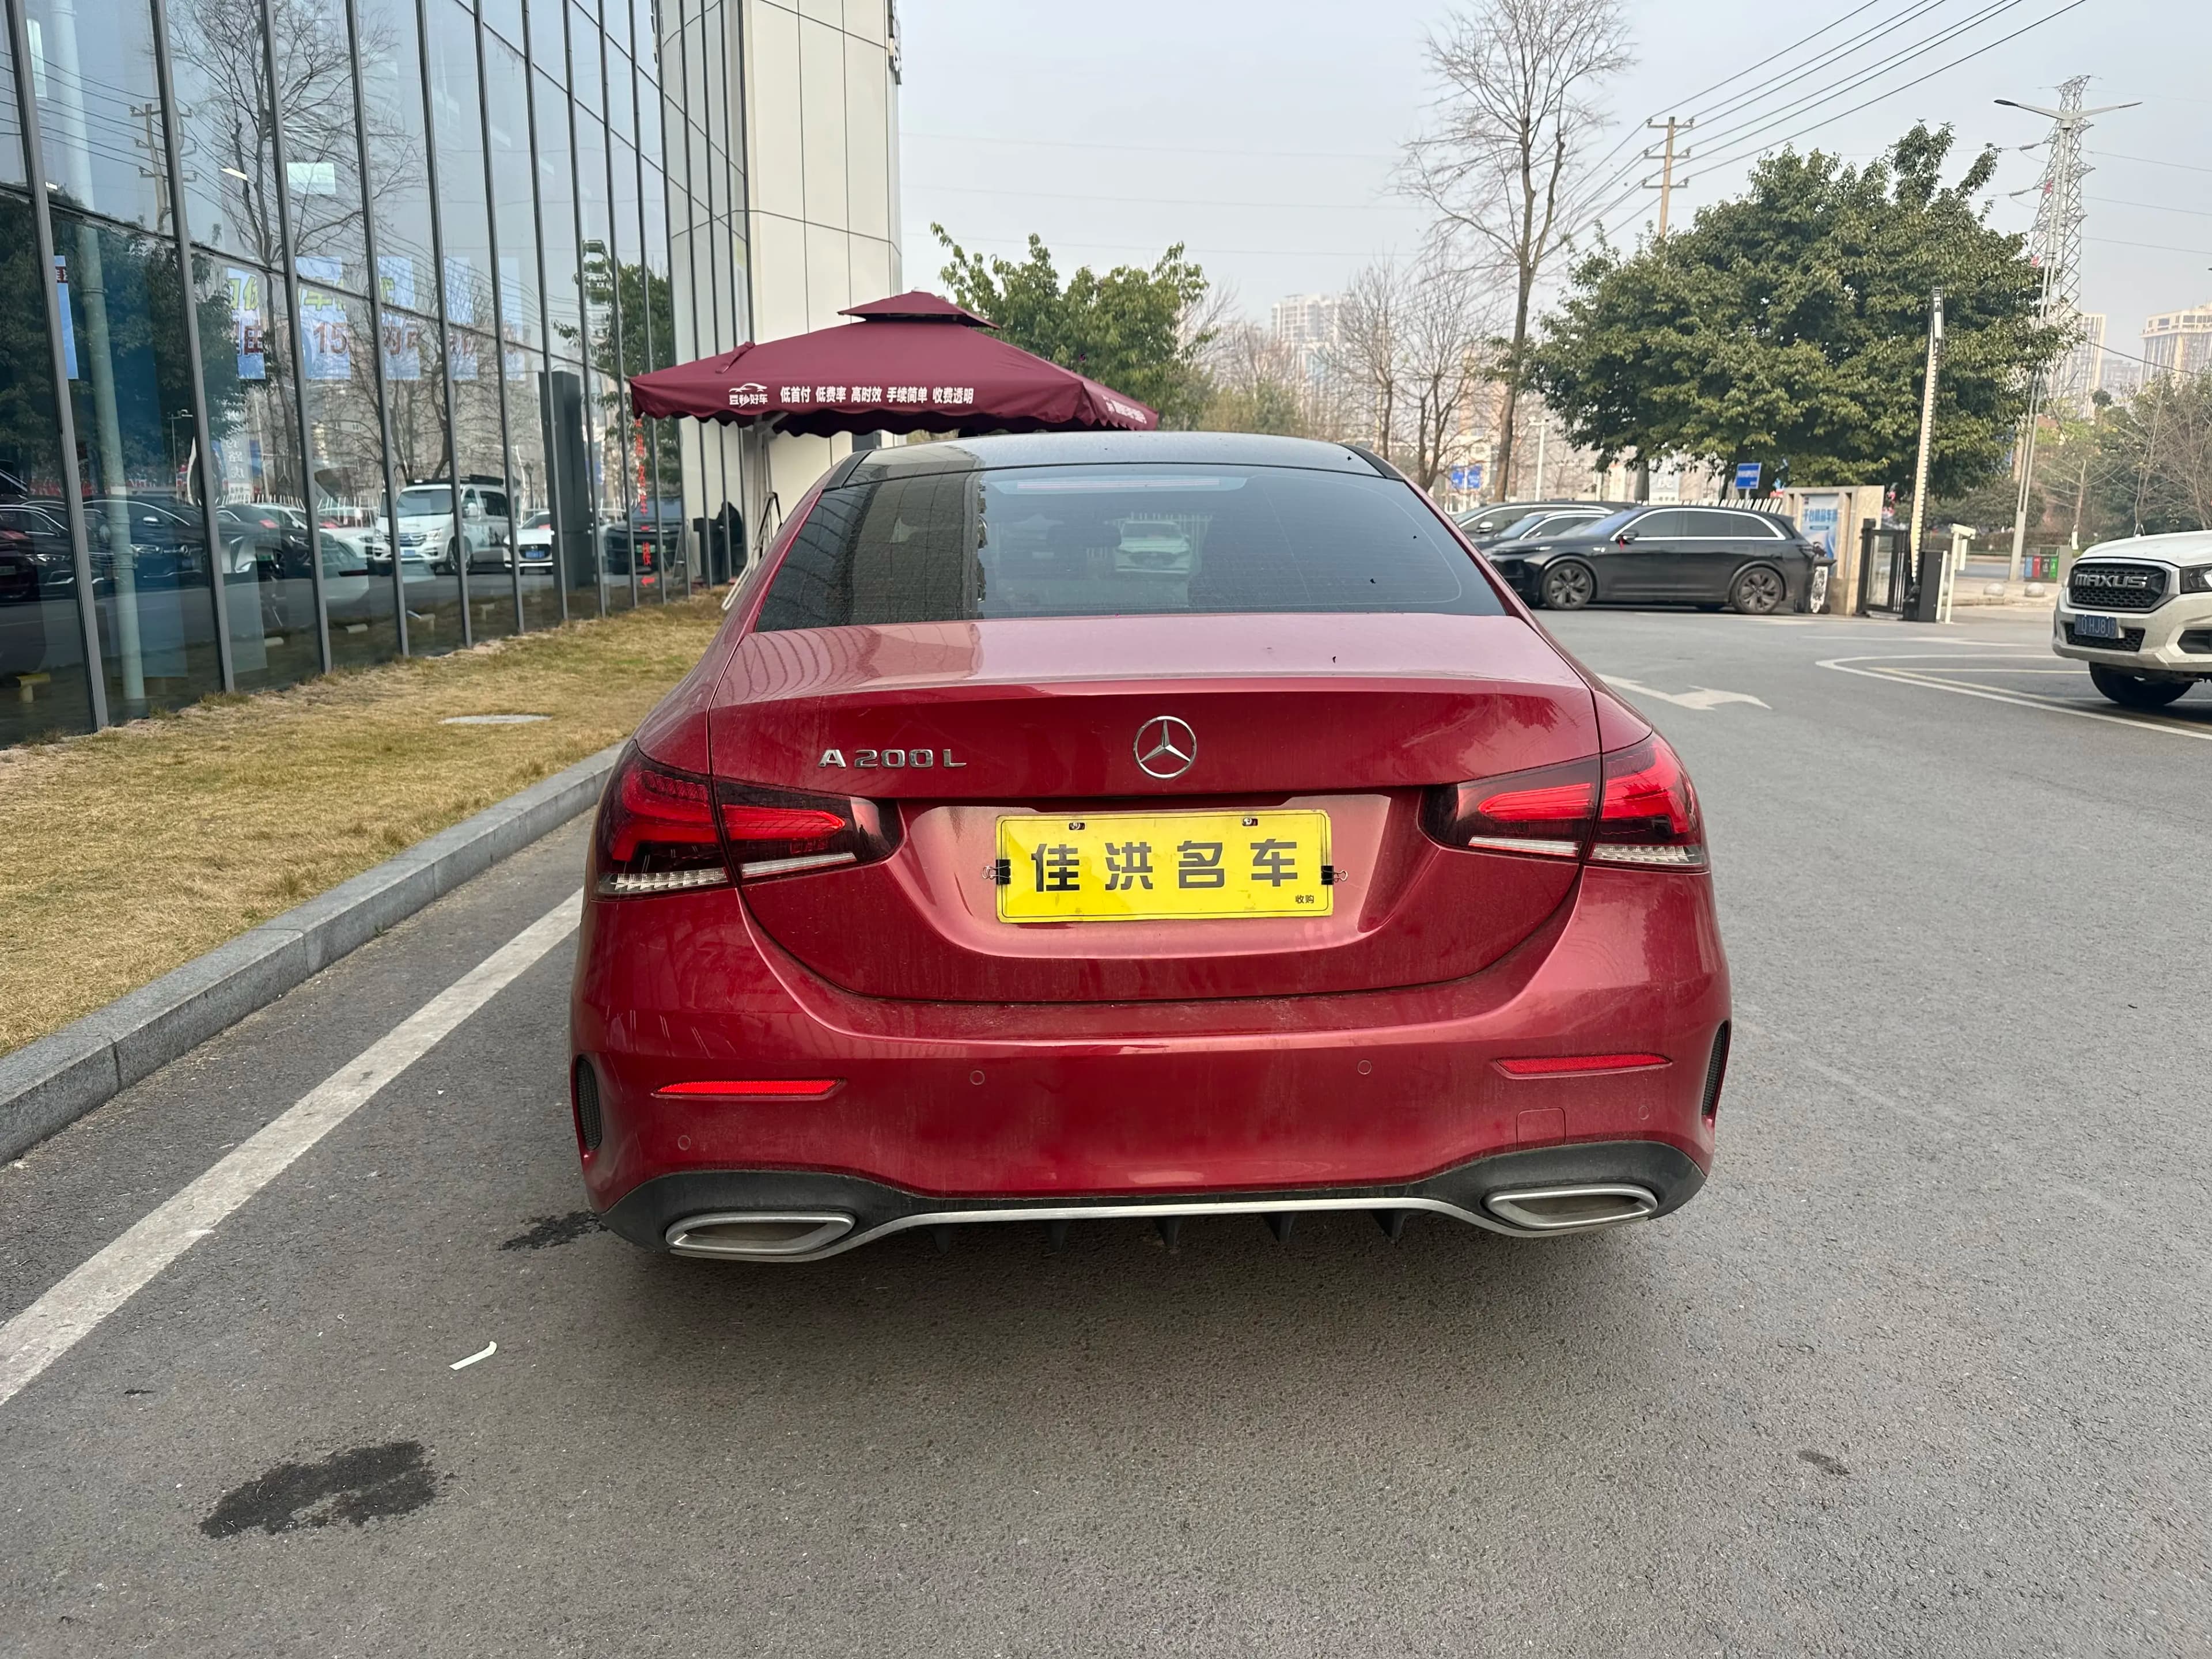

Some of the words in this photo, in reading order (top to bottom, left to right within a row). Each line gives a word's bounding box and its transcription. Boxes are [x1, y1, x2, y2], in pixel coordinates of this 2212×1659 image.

[781, 386, 810, 403] 低首付
[816, 386, 847, 403] 低费率
[851, 386, 882, 403] 高时效
[887, 387, 928, 403] 手续简单
[933, 387, 974, 404] 收费透明
[2075, 574, 2147, 588] MAXUS
[818, 749, 846, 768] A
[854, 749, 933, 768] 200
[942, 749, 967, 767] L
[1031, 839, 1298, 892] 佳洪名车
[1295, 894, 1315, 904] 收购
